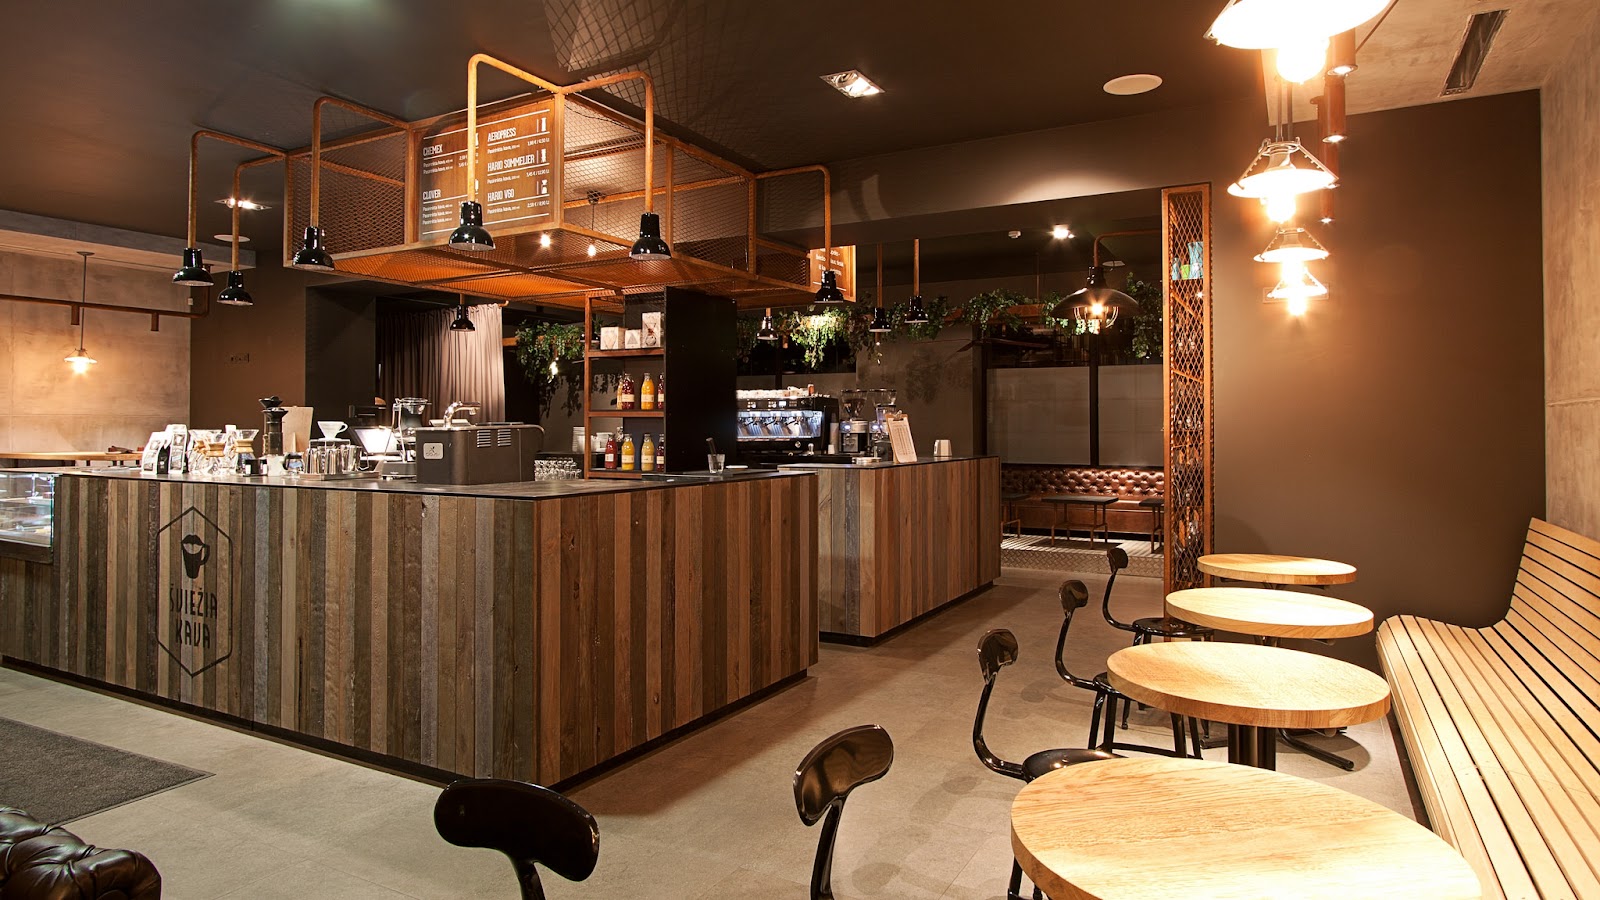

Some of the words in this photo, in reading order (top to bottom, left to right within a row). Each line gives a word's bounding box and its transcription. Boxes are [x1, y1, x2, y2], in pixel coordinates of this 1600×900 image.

[487, 127, 516, 142] AEROPRESS
[423, 144, 443, 156] CHEMEX
[488, 160, 503, 171] HARIO
[504, 154, 534, 168] SOMMELIER
[423, 189, 441, 200] CLOVER
[488, 191, 503, 202] HARIO
[504, 188, 514, 199] V60
[170, 584, 218, 619] ŠVIEŽIA
[176, 620, 210, 649] KAVA
